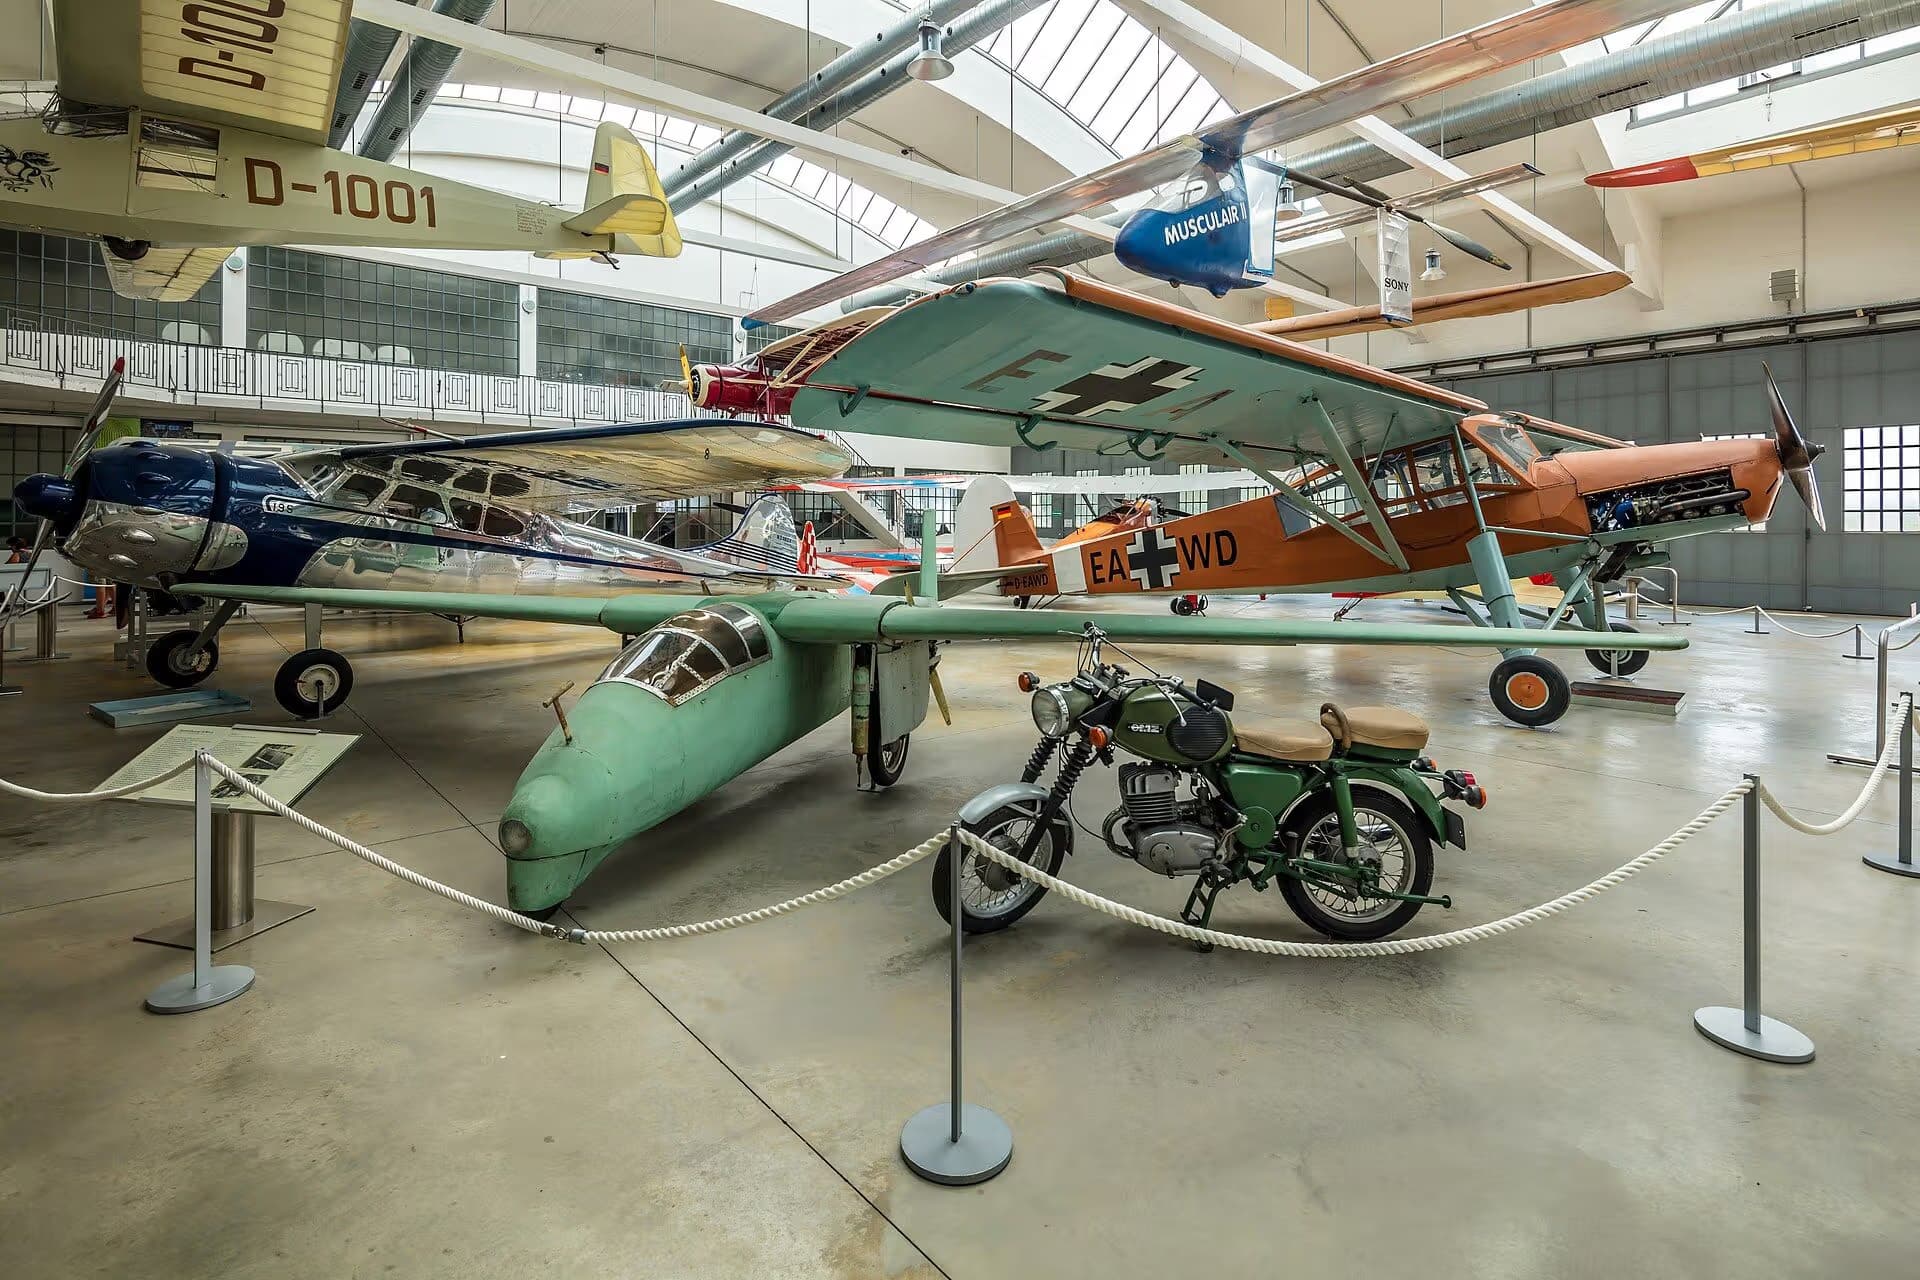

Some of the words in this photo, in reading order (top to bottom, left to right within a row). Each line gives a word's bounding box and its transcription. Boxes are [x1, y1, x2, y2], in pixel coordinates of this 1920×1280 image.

[244, 157, 436, 228] D-1001
[1164, 205, 1239, 246] MUSCULAIR
[1384, 277, 1409, 292] SONY
[1089, 548, 1127, 584] EA
[1179, 529, 1238, 571] WD
